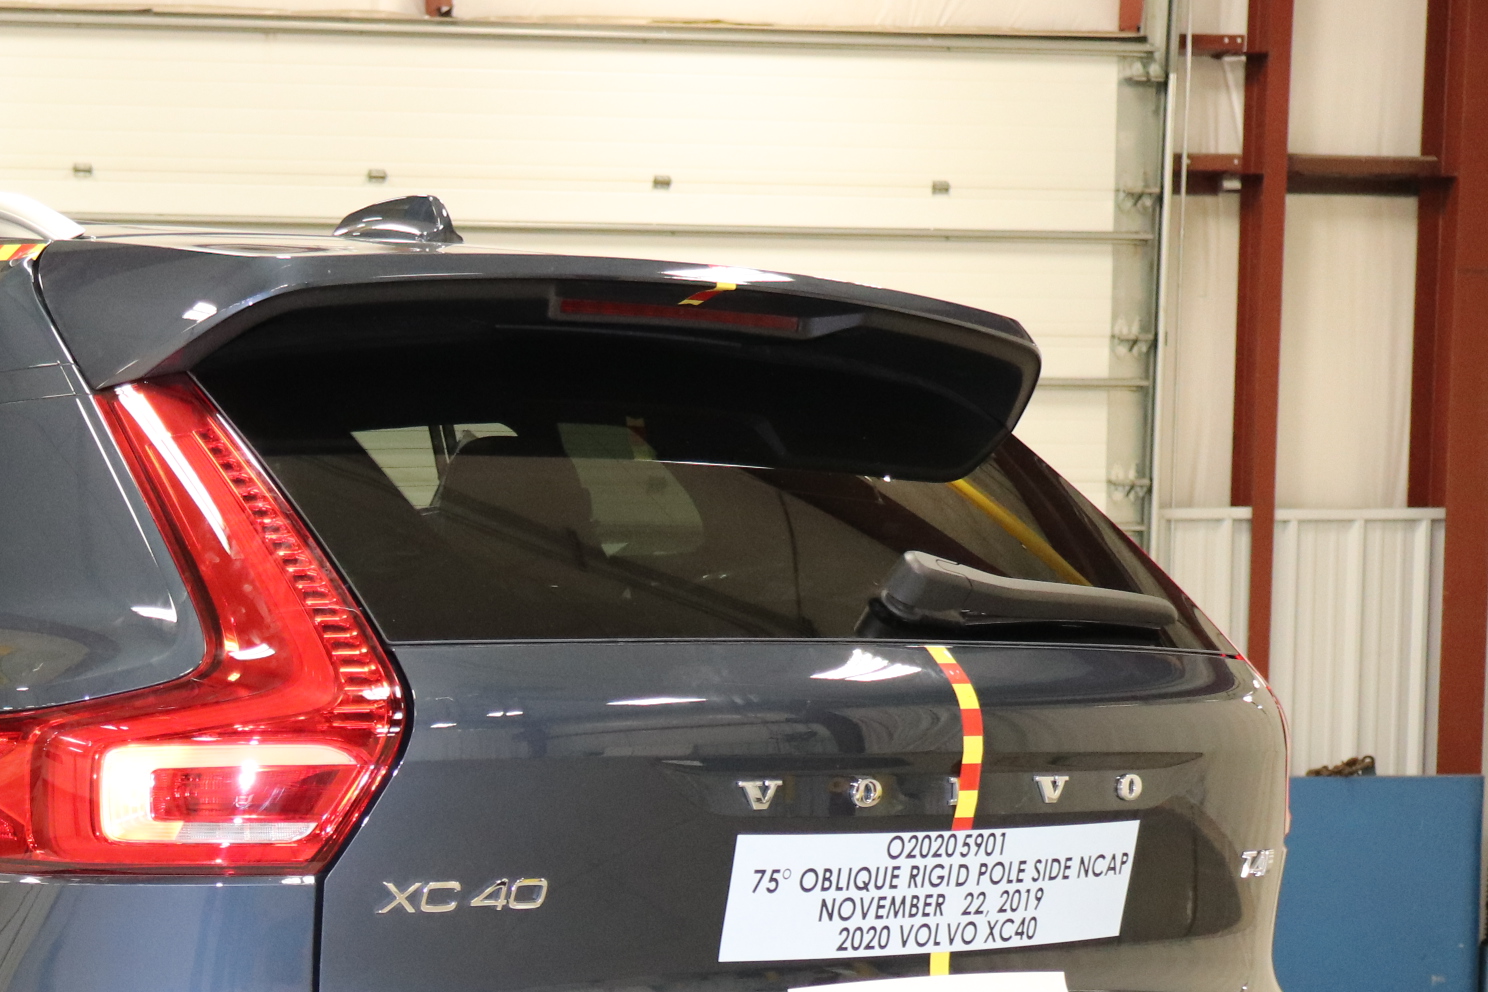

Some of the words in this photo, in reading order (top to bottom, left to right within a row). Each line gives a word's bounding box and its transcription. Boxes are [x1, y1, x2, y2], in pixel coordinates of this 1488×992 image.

[751, 868, 792, 894] 75°
[799, 866, 902, 893] OBLIQUE
[907, 863, 970, 888] RIGID
[976, 860, 1028, 886] POLE
[1031, 857, 1073, 883] SIDE
[1076, 852, 1129, 879] NCAP
[817, 894, 946, 922] NOVEMBER
[960, 891, 990, 918] 22,
[996, 887, 1044, 914] 2019
[835, 924, 891, 952] 2020
[899, 921, 978, 948] VOLVO
[983, 916, 1038, 944] XC40
